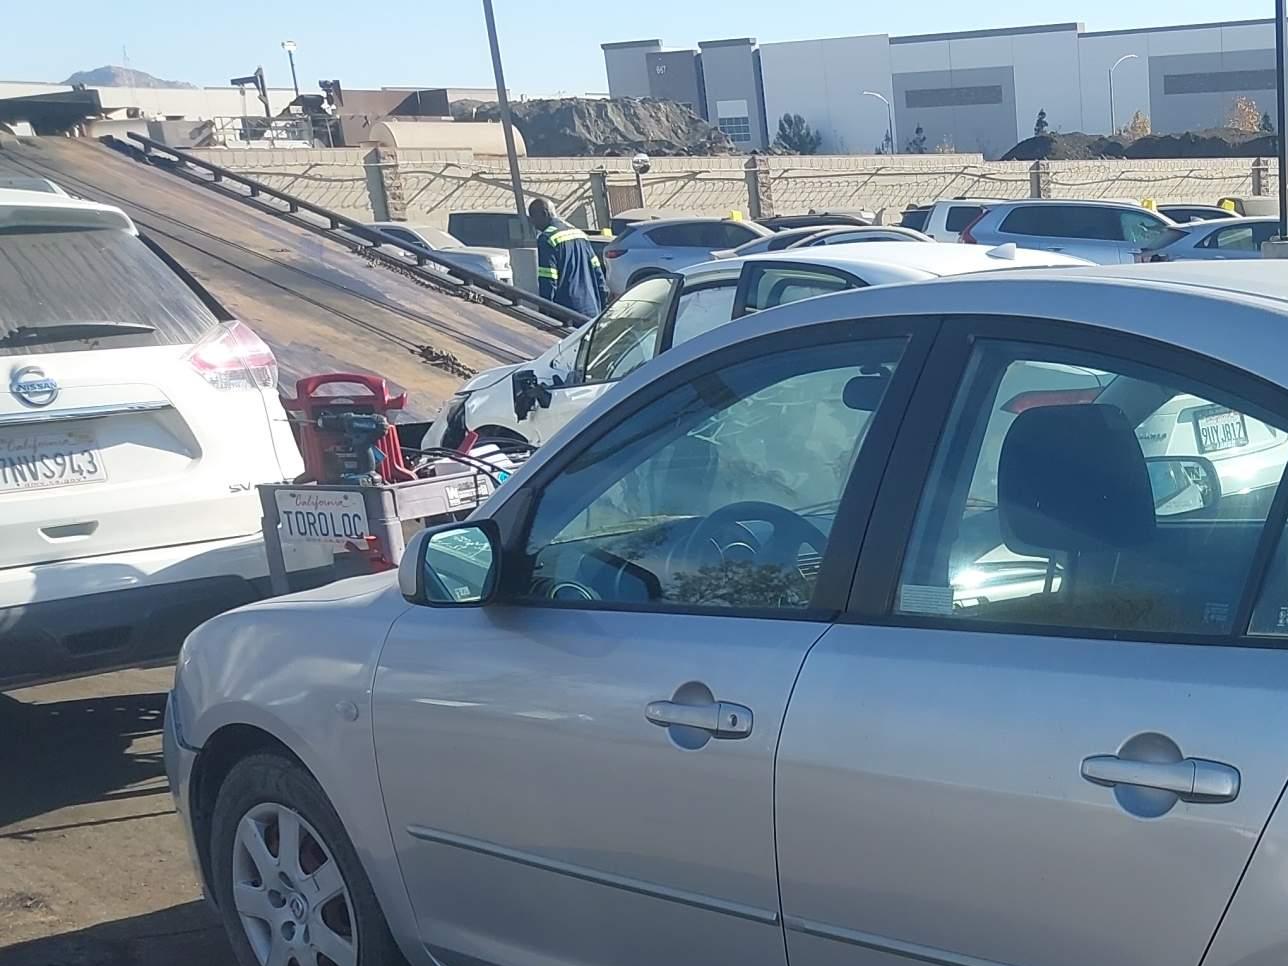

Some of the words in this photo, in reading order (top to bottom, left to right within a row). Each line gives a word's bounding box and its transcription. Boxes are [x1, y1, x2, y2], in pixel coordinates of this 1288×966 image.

[15, 382, 58, 393] NISSAN
[228, 481, 251, 493] SV
[283, 510, 364, 539] TOROLOC
